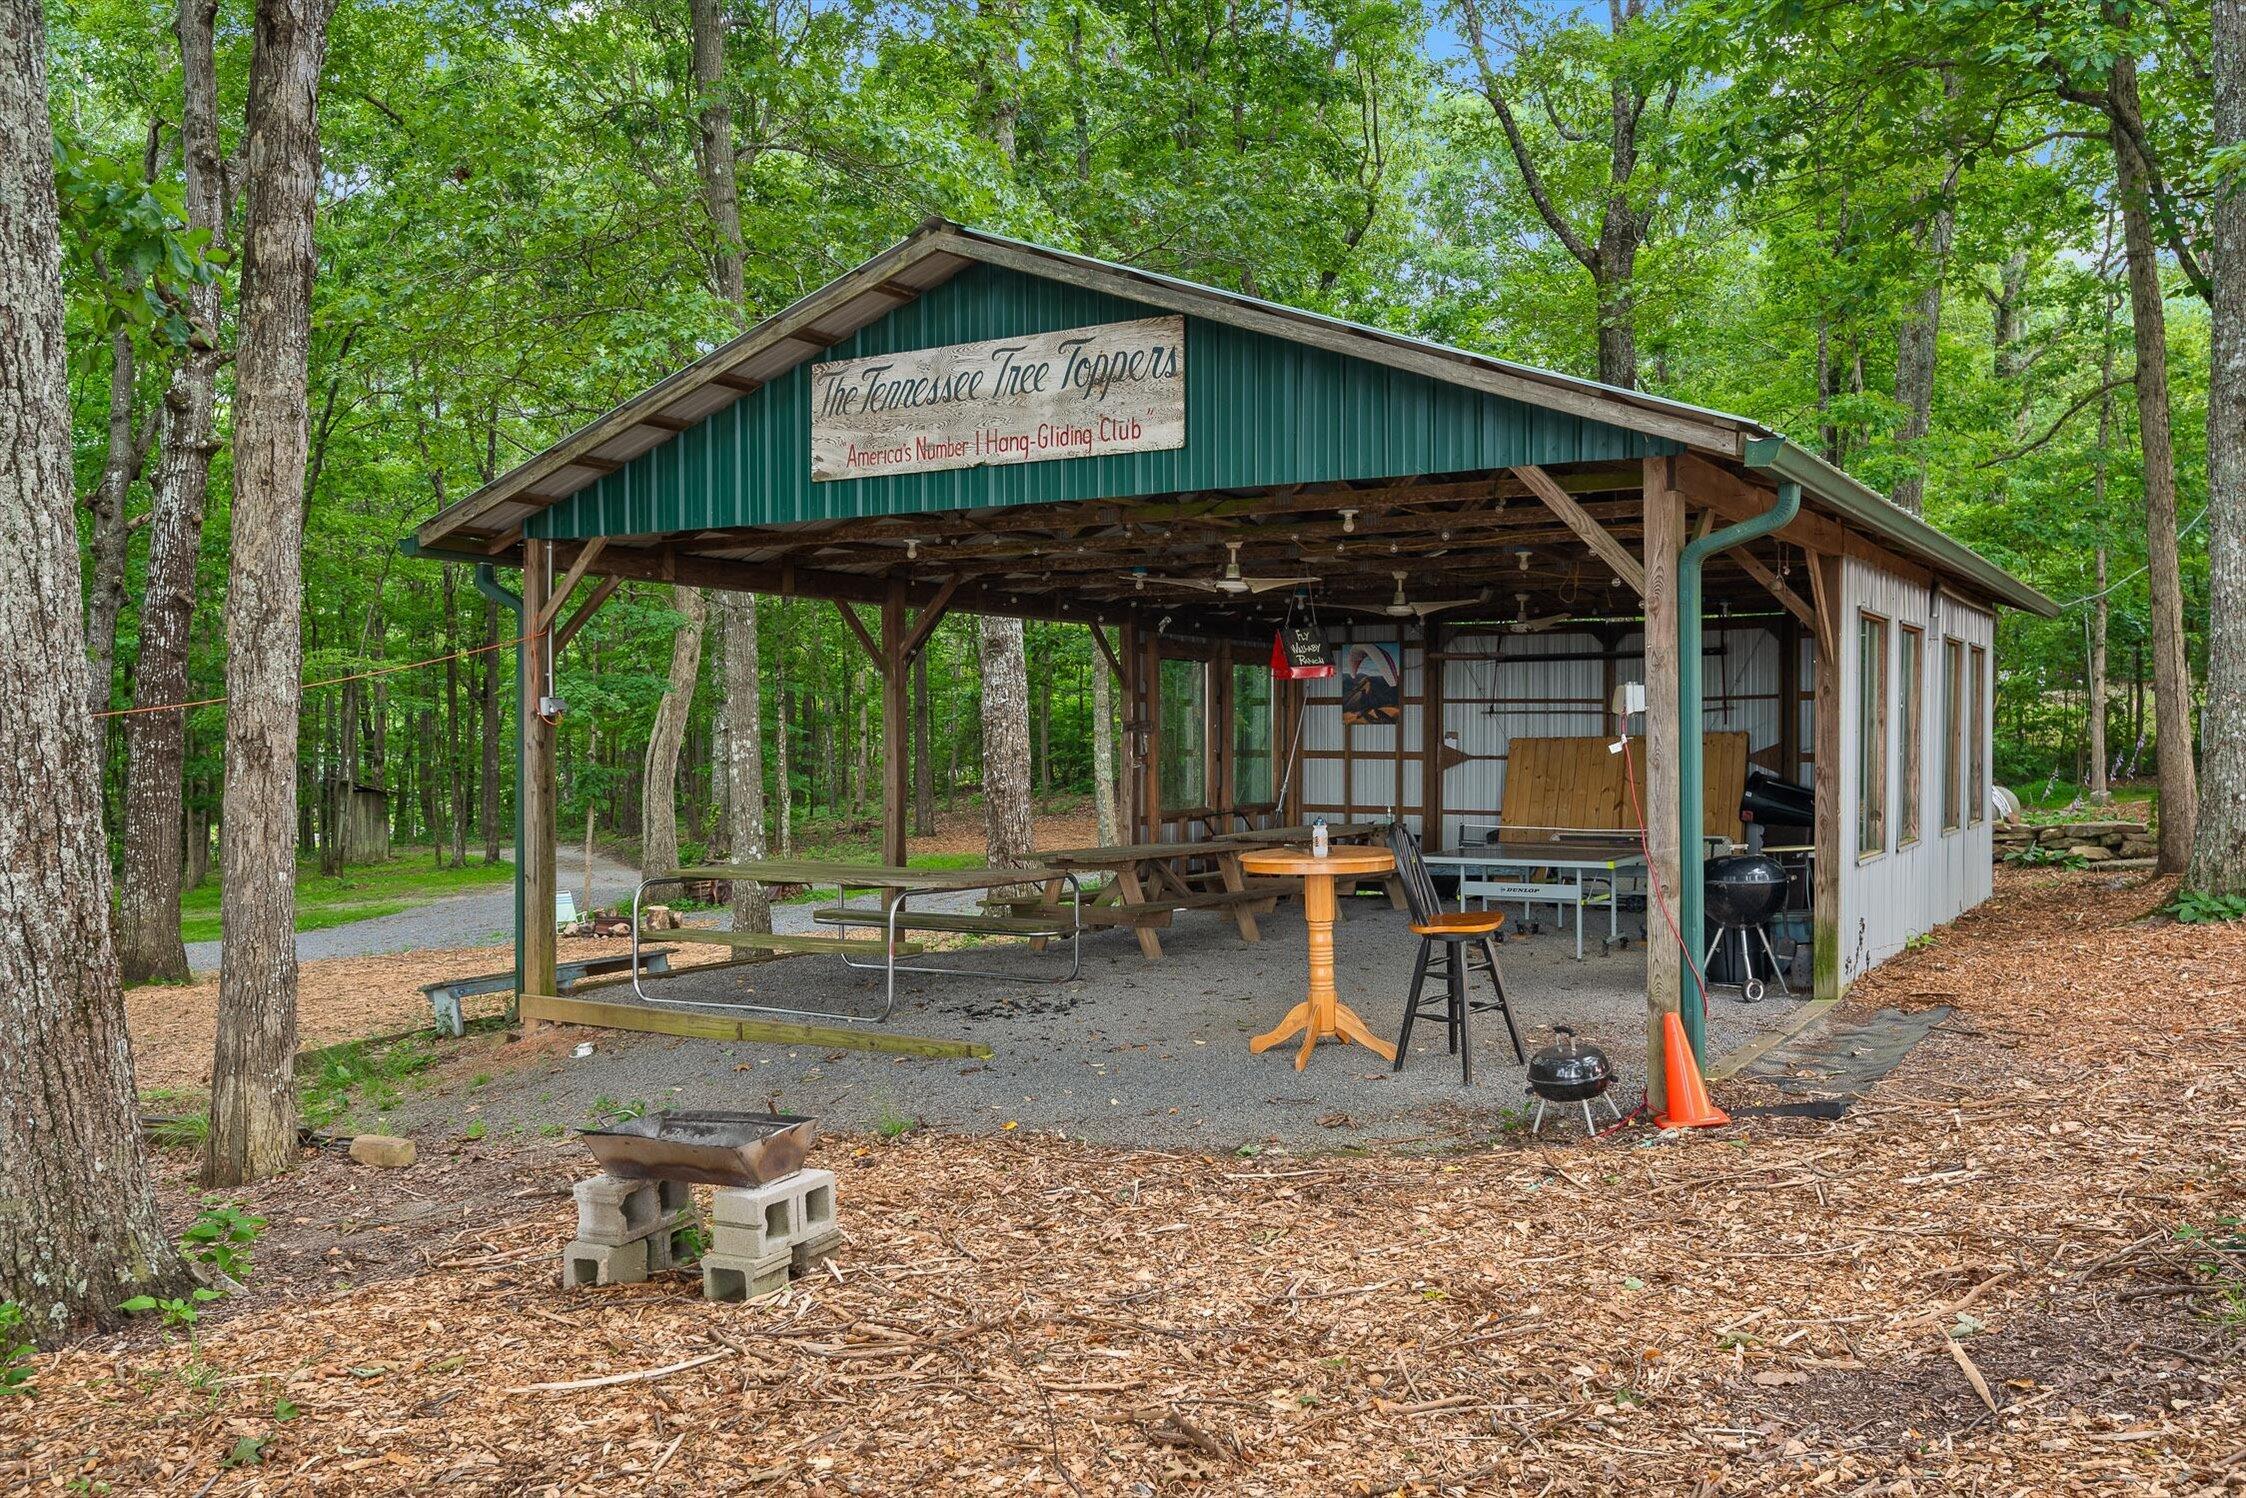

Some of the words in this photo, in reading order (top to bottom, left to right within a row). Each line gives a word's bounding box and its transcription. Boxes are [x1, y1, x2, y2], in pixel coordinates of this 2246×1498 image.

[817, 368, 858, 418] The
[860, 364, 984, 415] Tennessee
[992, 345, 1050, 399] Tree
[1058, 336, 1177, 401] Toppers
[916, 435, 969, 462] Number
[986, 423, 1093, 459] Hang-Gliding
[1295, 629, 1310, 641] FLY
